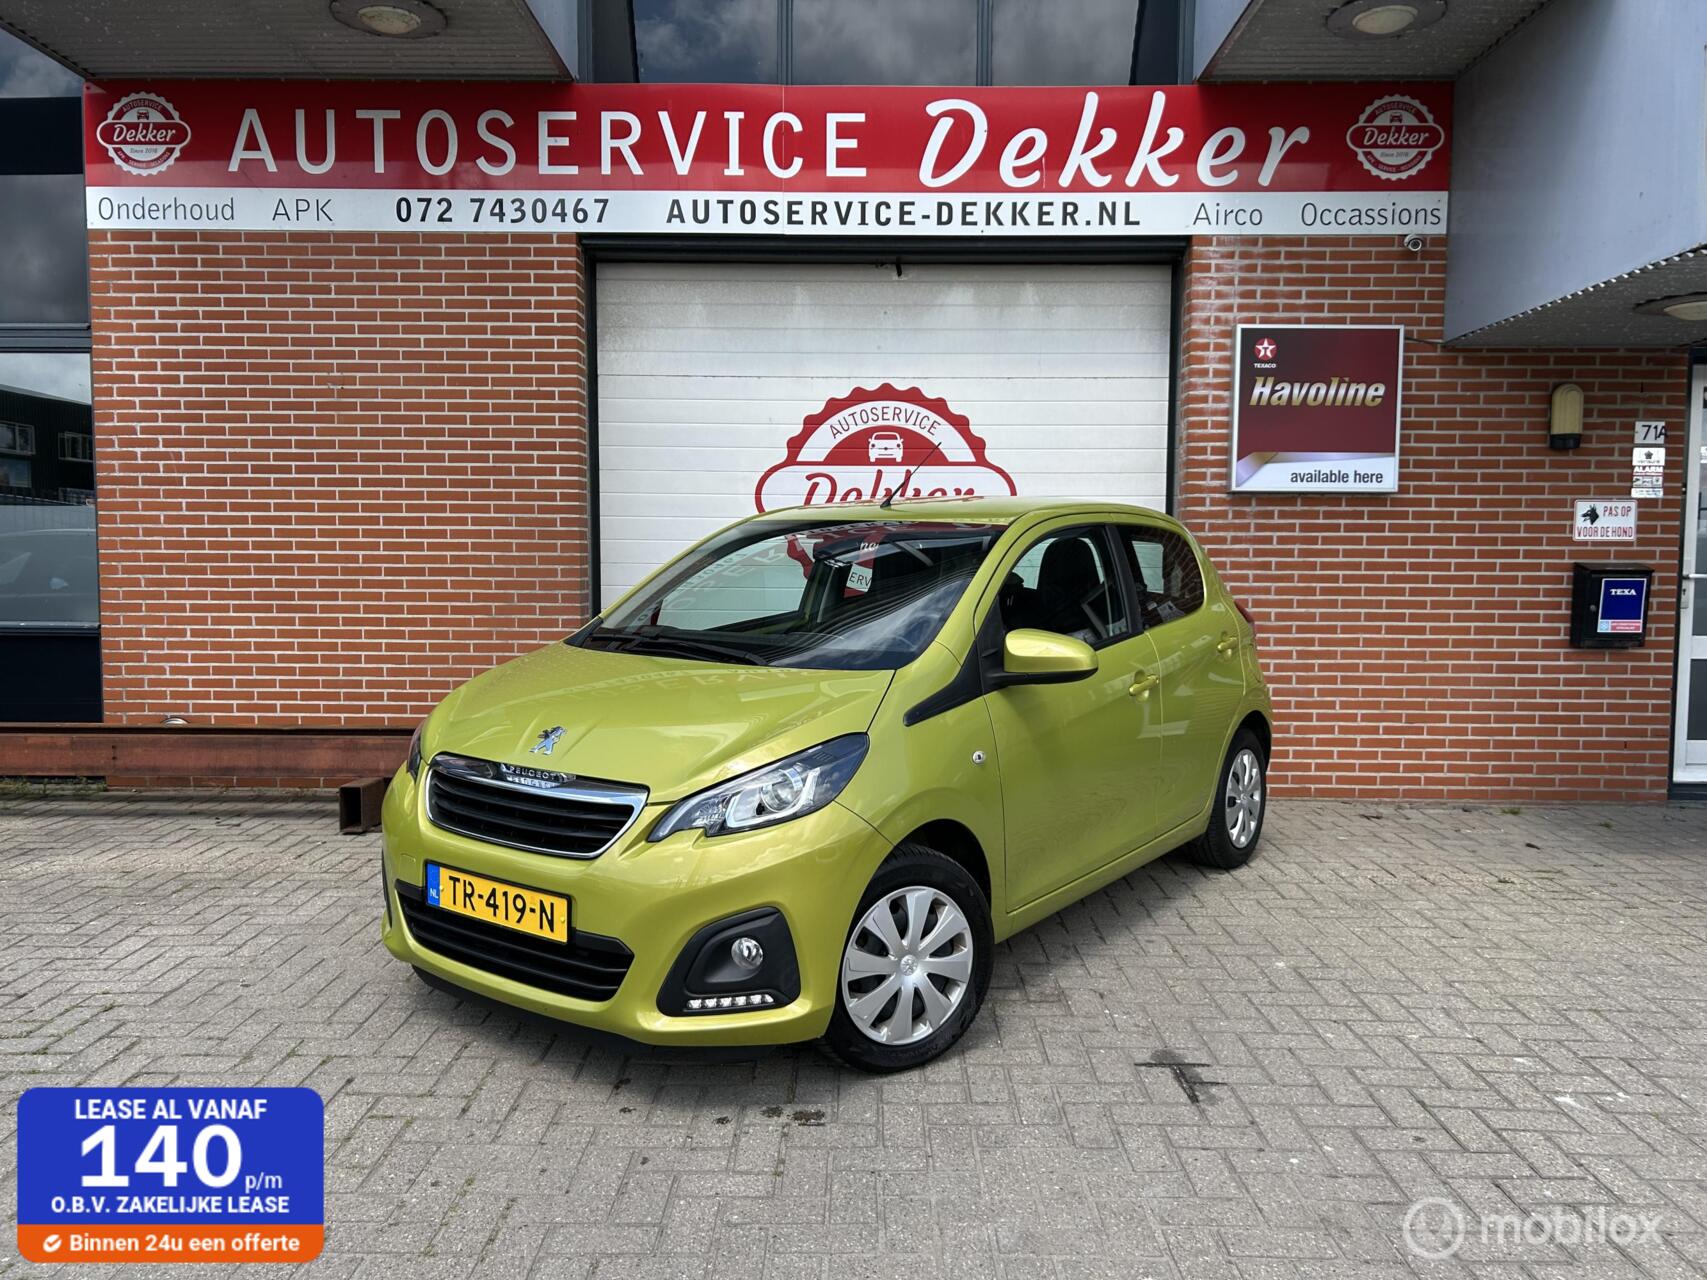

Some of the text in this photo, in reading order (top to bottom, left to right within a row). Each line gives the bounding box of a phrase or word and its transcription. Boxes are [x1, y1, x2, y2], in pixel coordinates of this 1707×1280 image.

[113, 122, 176, 142] Dekker
[228, 90, 1310, 188] AUTOSERVICE Dekker
[1363, 125, 1429, 145] Dekker
[98, 196, 1441, 227] Onderhoud APK 072 7430467 AUTOSERVICE-DEKKER.NL Airco Occassions
[1249, 376, 1386, 407] Havoline
[829, 406, 942, 439] AUTOSERVICE
[1641, 424, 1669, 441] 71A
[1290, 470, 1384, 483] available here
[1602, 505, 1632, 518] PAS OP
[1576, 526, 1633, 538] VOOR DE HOND
[1609, 588, 1637, 596] TEXA
[509, 765, 556, 781] PEUGEOT
[429, 874, 555, 933] NL TR-419-N
